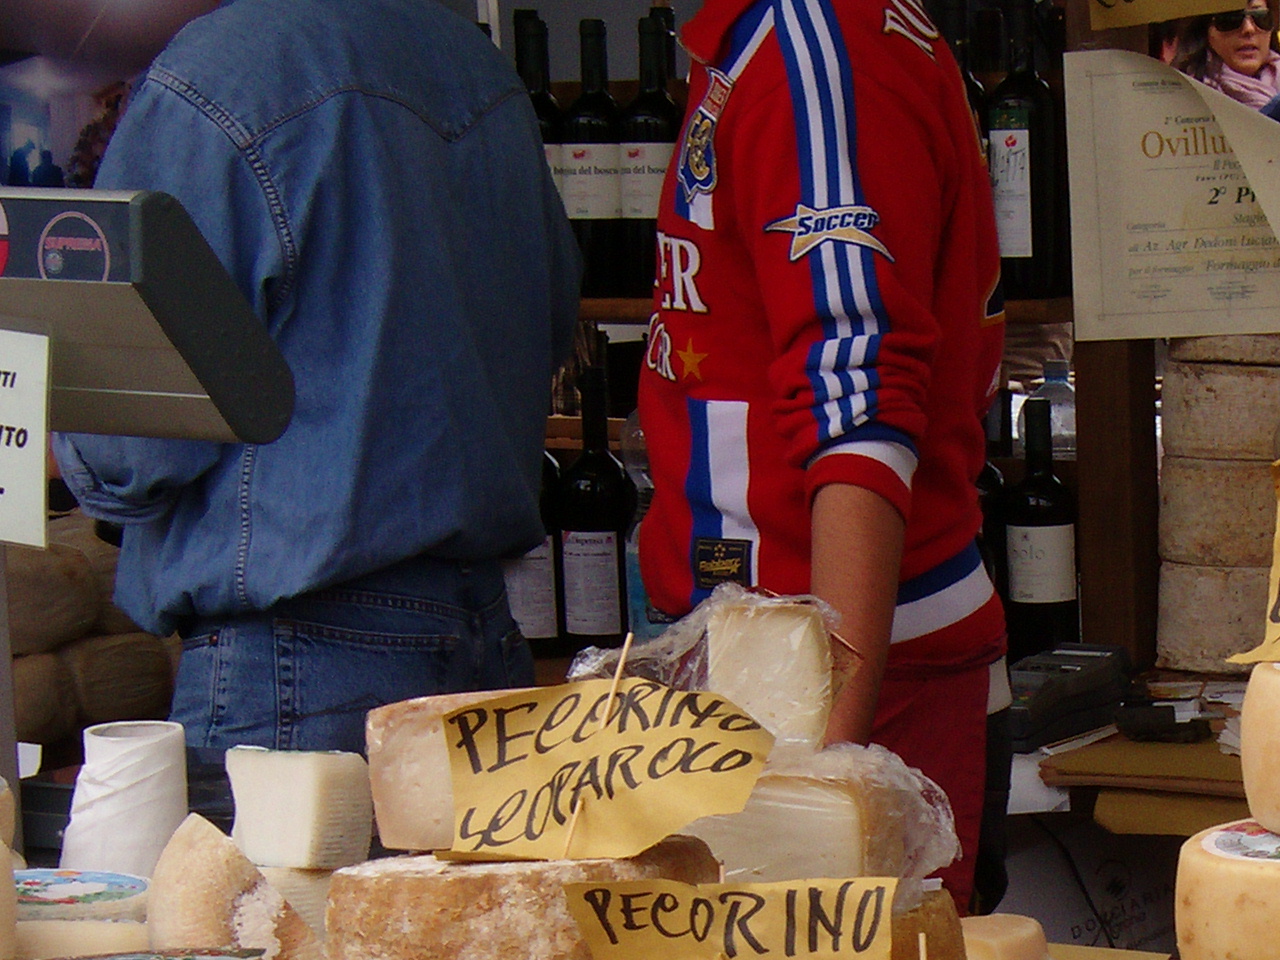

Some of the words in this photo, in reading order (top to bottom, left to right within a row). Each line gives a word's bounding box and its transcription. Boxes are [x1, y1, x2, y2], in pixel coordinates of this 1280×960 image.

[1140, 126, 1235, 160] Ovillu
[797, 210, 879, 237] Soccer
[447, 682, 762, 775] PECORINO
[584, 880, 886, 958] PECORINO
